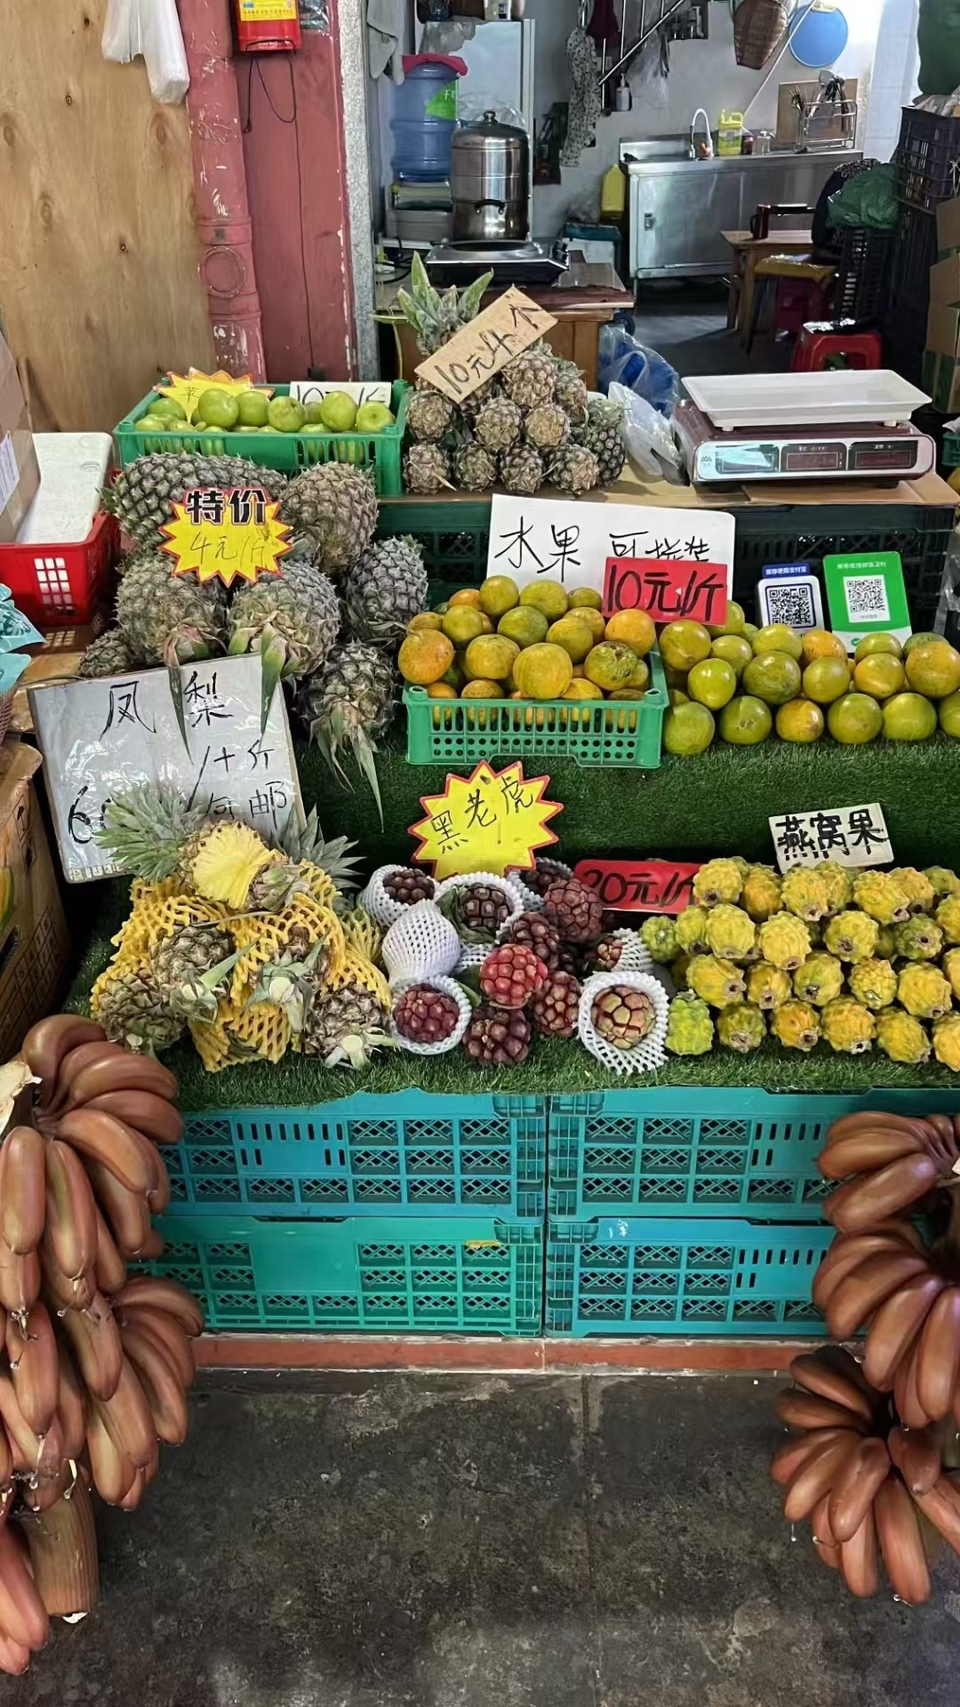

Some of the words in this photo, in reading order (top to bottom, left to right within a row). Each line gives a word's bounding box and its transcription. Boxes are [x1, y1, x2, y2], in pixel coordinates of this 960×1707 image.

[186, 489, 267, 524] 特价
[494, 516, 581, 583] 水果
[608, 564, 725, 622] 10元/斤
[98, 670, 234, 742] 凤梨
[431, 776, 533, 854] 黑老虎
[775, 808, 890, 861] 燕窝果
